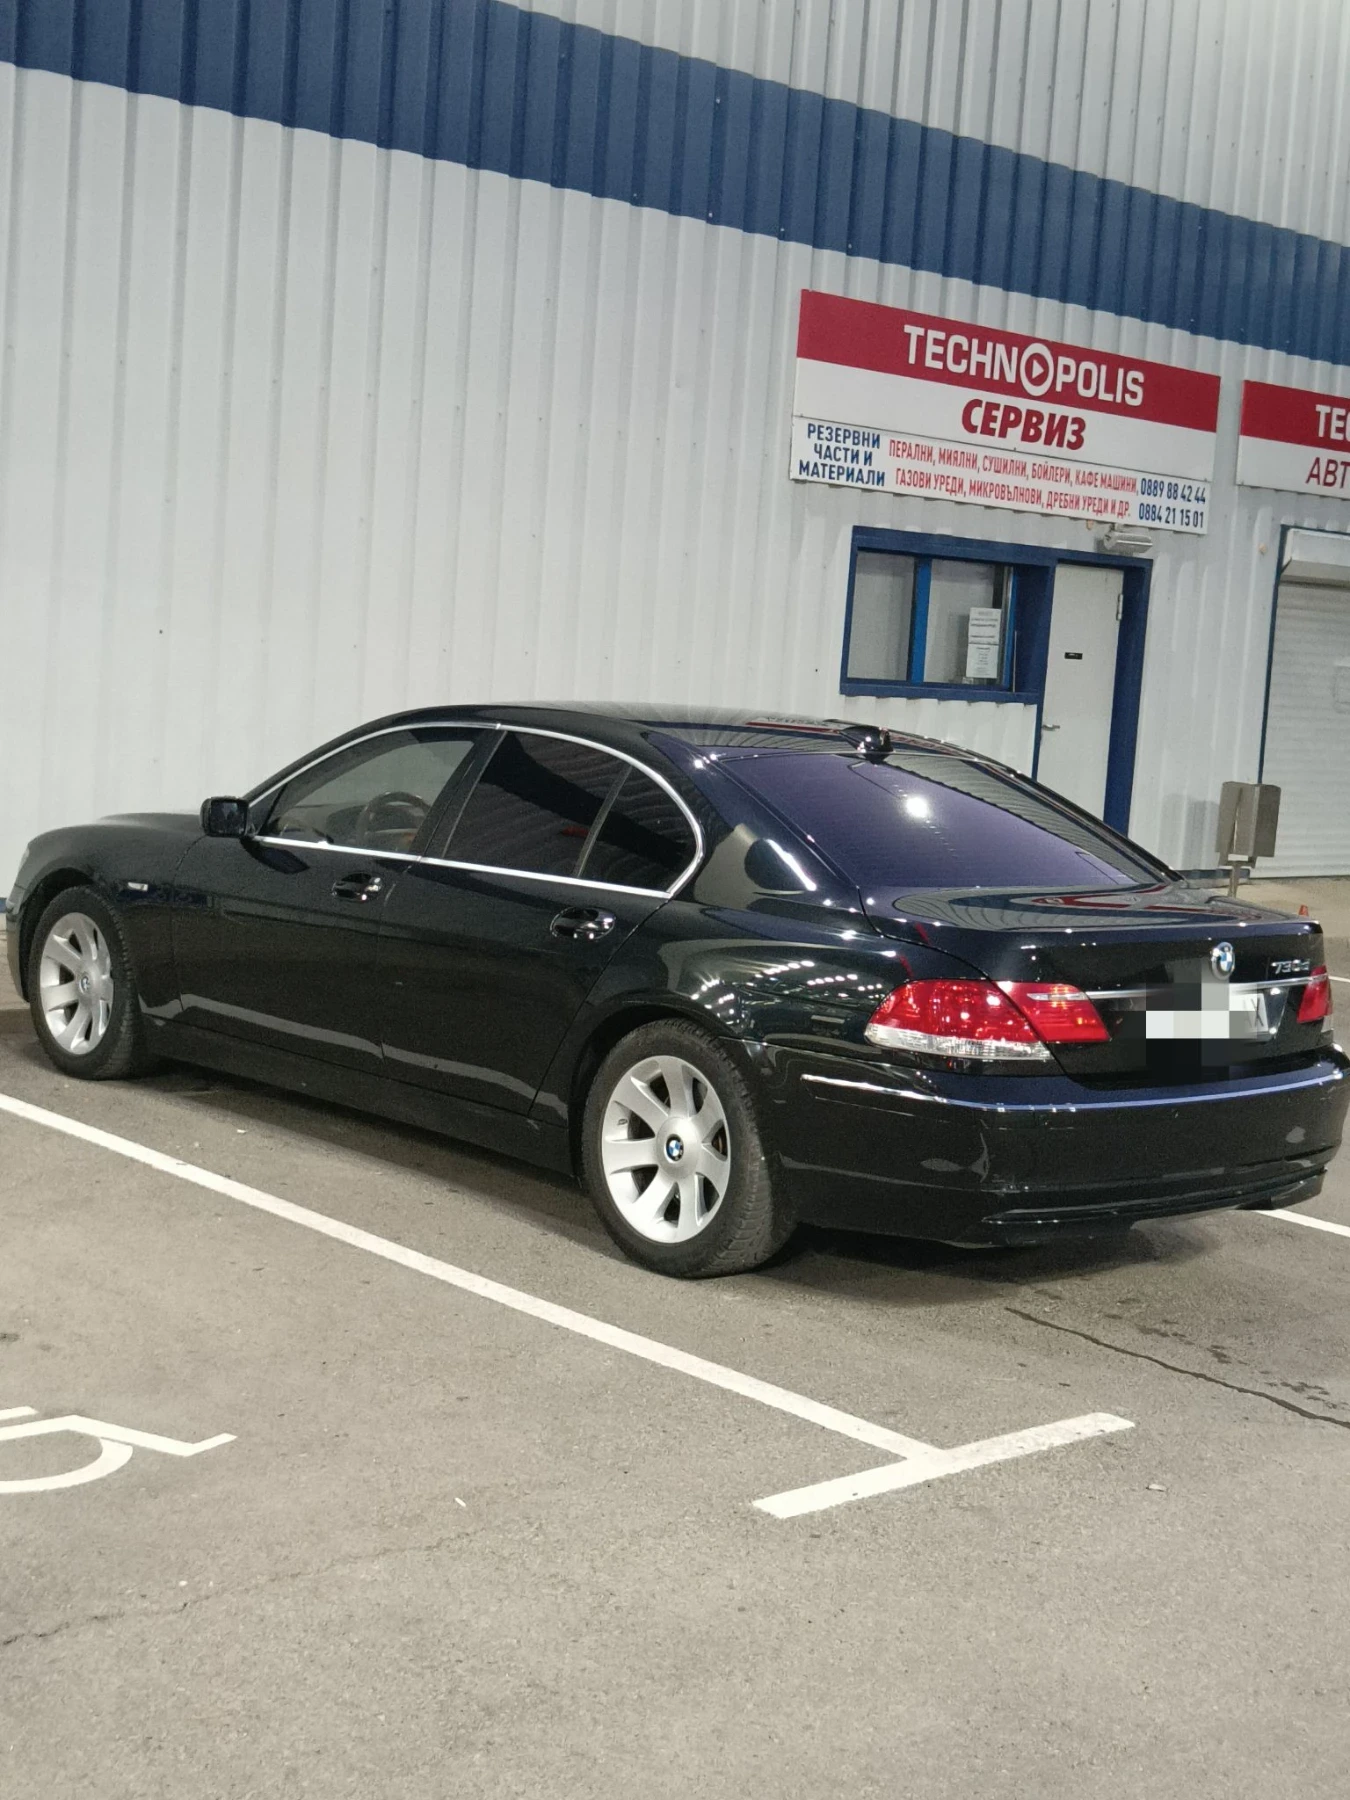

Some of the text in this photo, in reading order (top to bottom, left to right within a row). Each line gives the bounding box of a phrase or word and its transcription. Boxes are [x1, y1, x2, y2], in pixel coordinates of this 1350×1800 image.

[903, 324, 1145, 407] TECHNOPOLIS
[807, 422, 880, 449] РЕЗЕРВНИ
[961, 398, 1086, 451] СЕРВИЗ
[813, 443, 873, 467] ЧАСТИ И
[889, 438, 1139, 496] ПЕРАЛНИ, МИЯЛНИ, СУШИЛНИ, БОЙЛЕРИ, КАФЕ МАШИНИ,
[798, 459, 885, 487] МАТЕРИАЛИ
[895, 467, 1131, 519] ГАЗОВИ УРЕДИ, МИКРОВЪЛНОВИ, ДРЕБНИ УРЕДИ И ДР.
[1140, 477, 1206, 505] 0889 88 42 44
[1138, 502, 1204, 528] 0884 21 15 01
